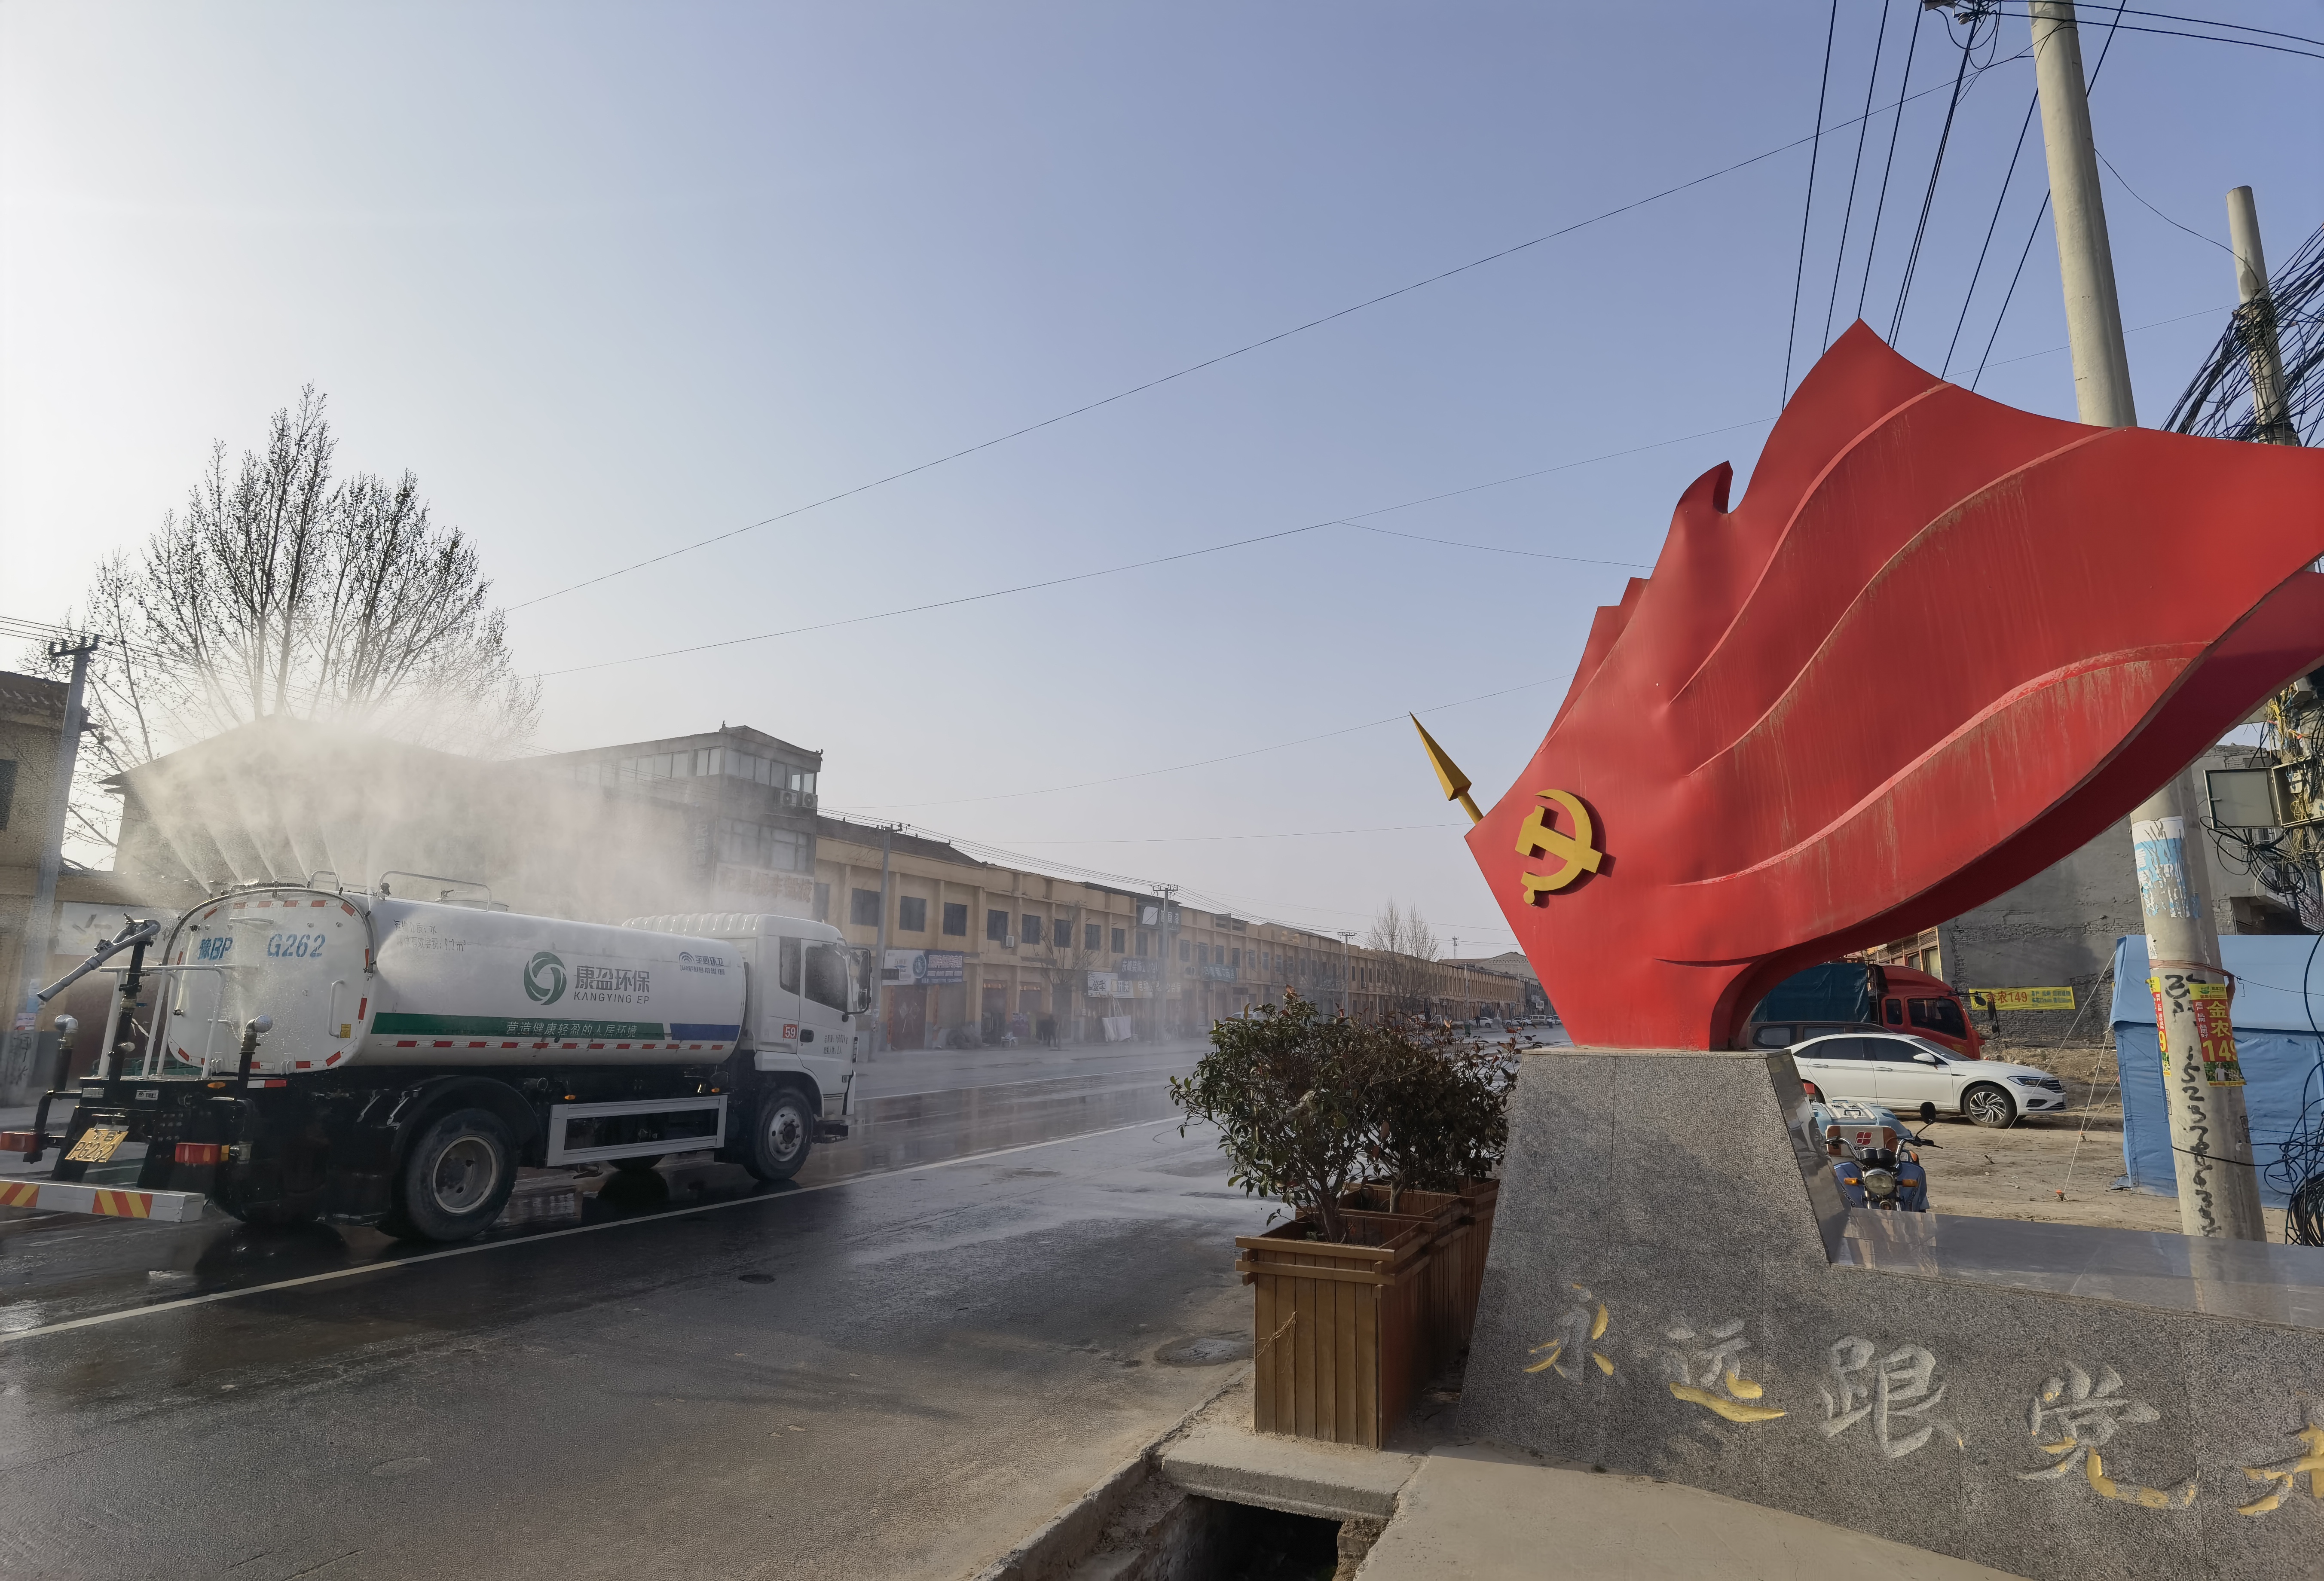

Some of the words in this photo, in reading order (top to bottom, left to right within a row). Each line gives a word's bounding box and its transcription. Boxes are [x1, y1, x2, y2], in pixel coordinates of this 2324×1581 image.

[267, 933, 326, 958] G262
[575, 965, 650, 992] 康盈环保
[574, 991, 632, 1003] KANGYING
[637, 995, 649, 1004] EP
[506, 1021, 637, 1038] 营造健康轻盈的人居环境
[2207, 1000, 2231, 1038] 金农
[785, 1027, 796, 1038] 59
